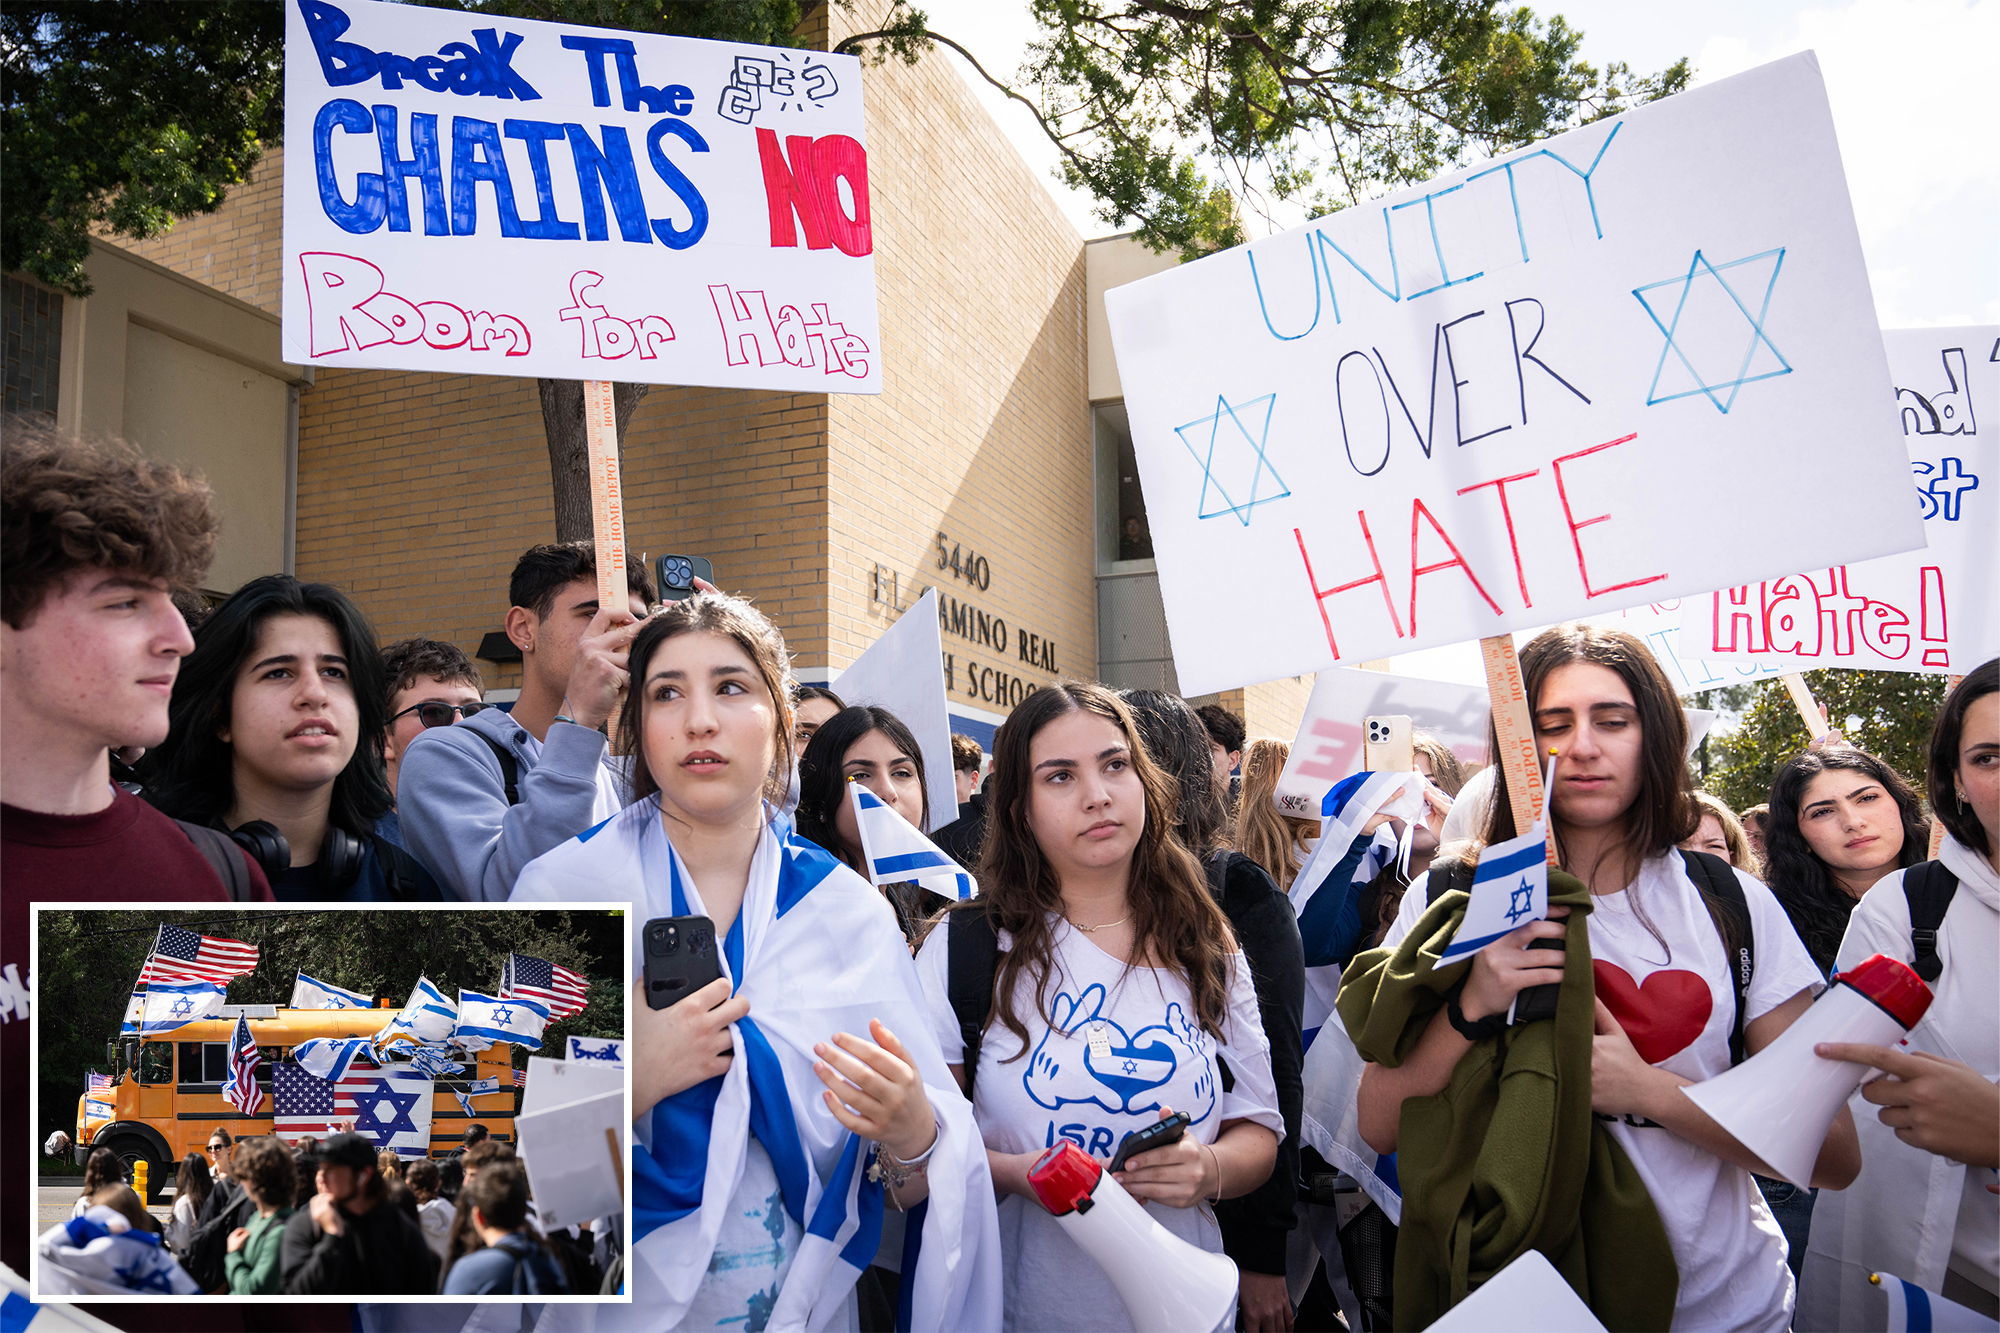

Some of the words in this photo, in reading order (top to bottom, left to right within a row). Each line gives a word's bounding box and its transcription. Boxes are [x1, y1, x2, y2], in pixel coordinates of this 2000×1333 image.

[561, 35, 695, 115] The
[313, 98, 710, 250] CHAINS
[755, 127, 873, 257] NO
[1247, 120, 1625, 341] UNITY
[299, 251, 532, 358] Room
[560, 270, 675, 360] for
[708, 283, 871, 379] Hate
[602, 395, 613, 427] HOME
[1336, 297, 1592, 476] OVER
[605, 455, 618, 498] DEPOT
[609, 501, 622, 541] HOME
[1294, 432, 1669, 660] HATE
[612, 544, 624, 572] THE
[937, 532, 990, 591] 5440
[874, 561, 907, 613] EL
[1018, 628, 1060, 674] REAL
[1712, 566, 1950, 668] Hate!
[1501, 641, 1514, 659] OF
[1505, 661, 1522, 701] HOME
[1519, 736, 1542, 789] DEPOT
[1740, 947, 1751, 985] adidas
[373, 1146, 398, 1155] RAEL
